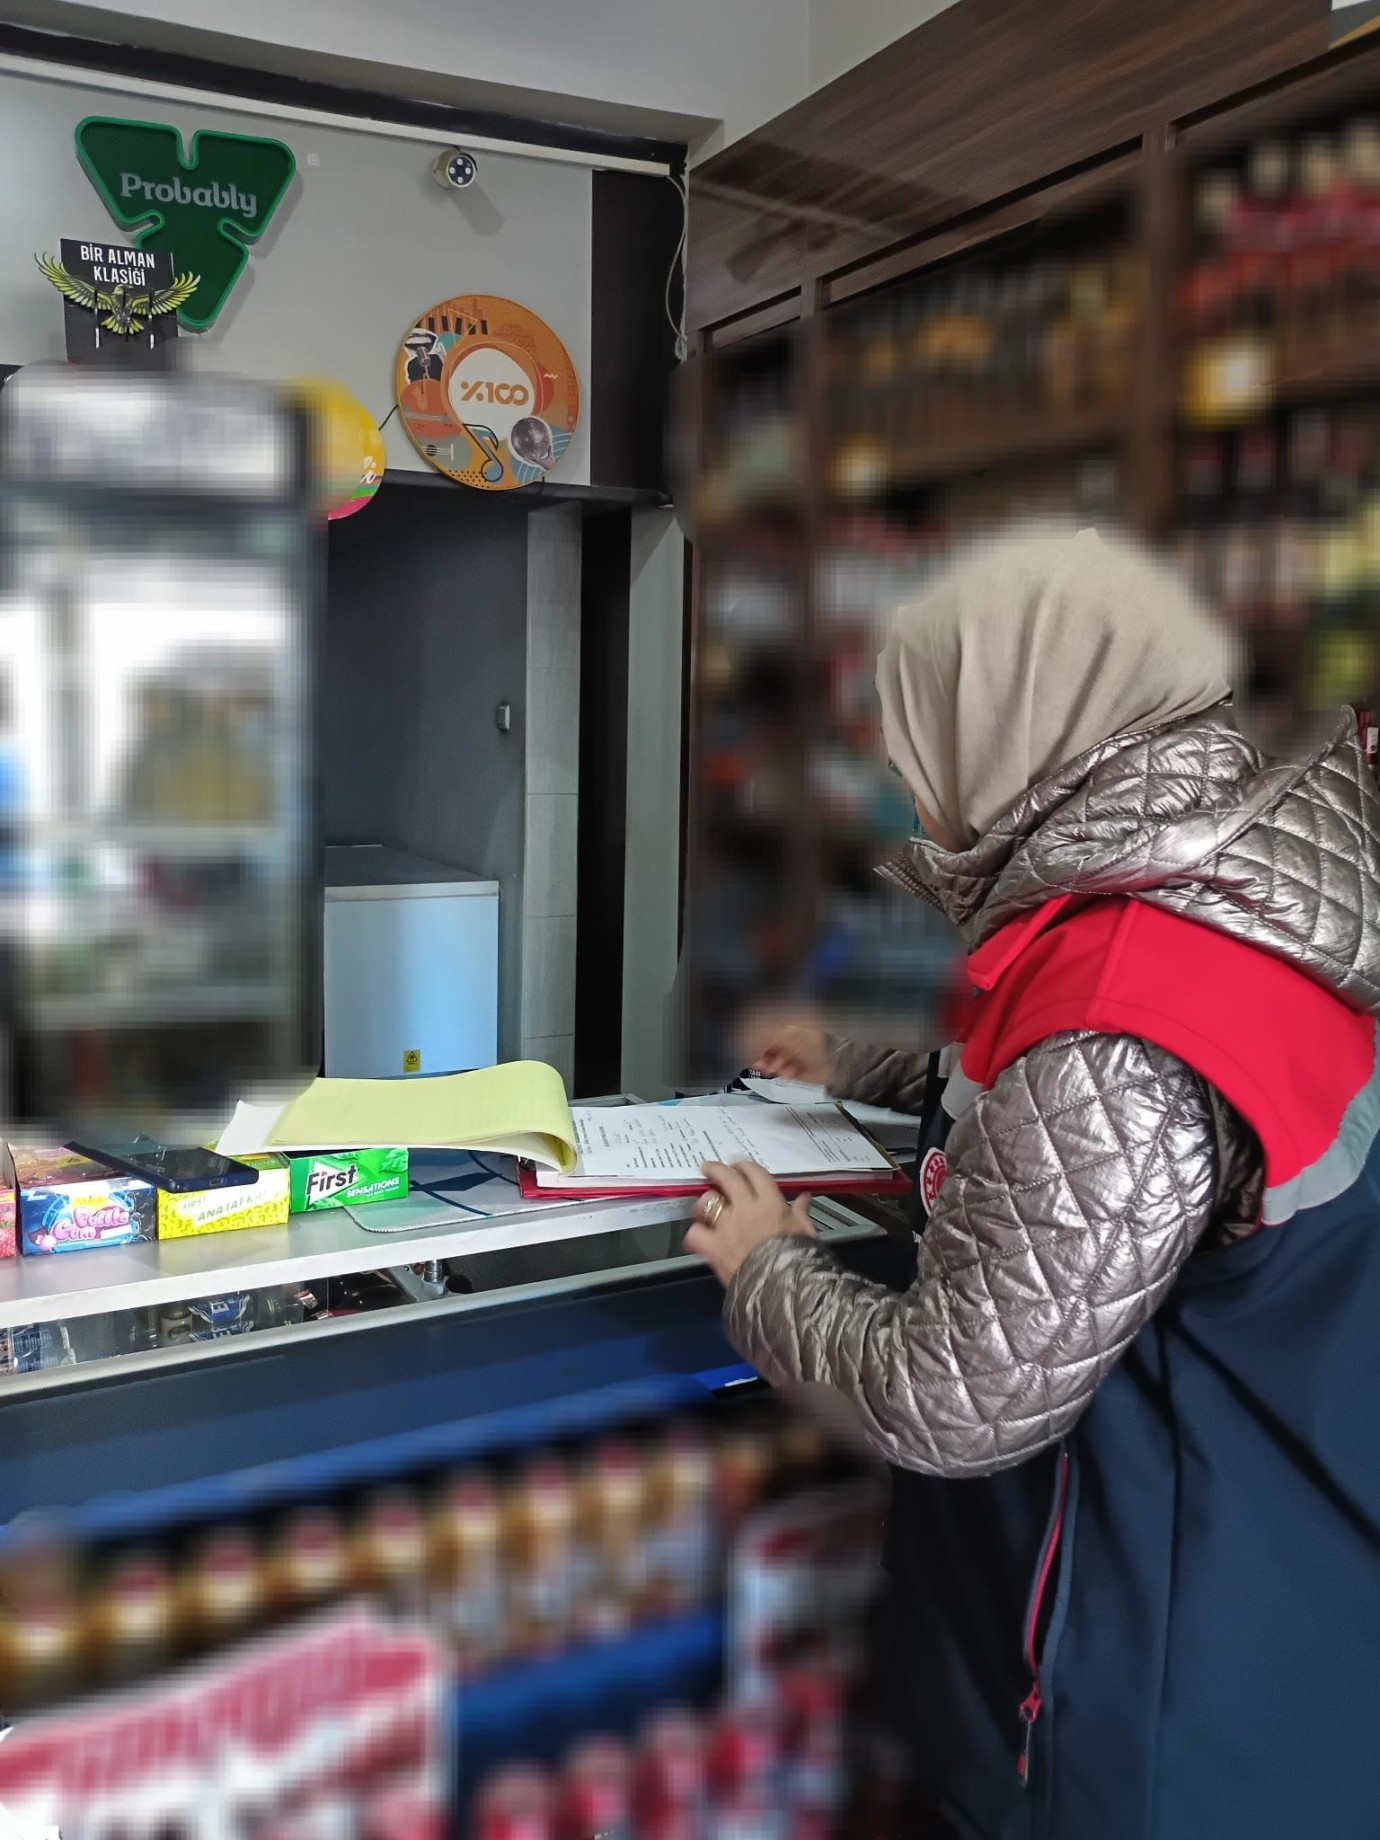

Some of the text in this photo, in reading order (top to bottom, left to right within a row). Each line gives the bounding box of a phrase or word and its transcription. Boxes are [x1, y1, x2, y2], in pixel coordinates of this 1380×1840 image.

[119, 172, 258, 218] Probably
[80, 243, 155, 269] BİR ALMAN
[93, 265, 146, 287] KLASİĞİ
[306, 1164, 357, 1196] First
[345, 1177, 400, 1199] SENSATIONS
